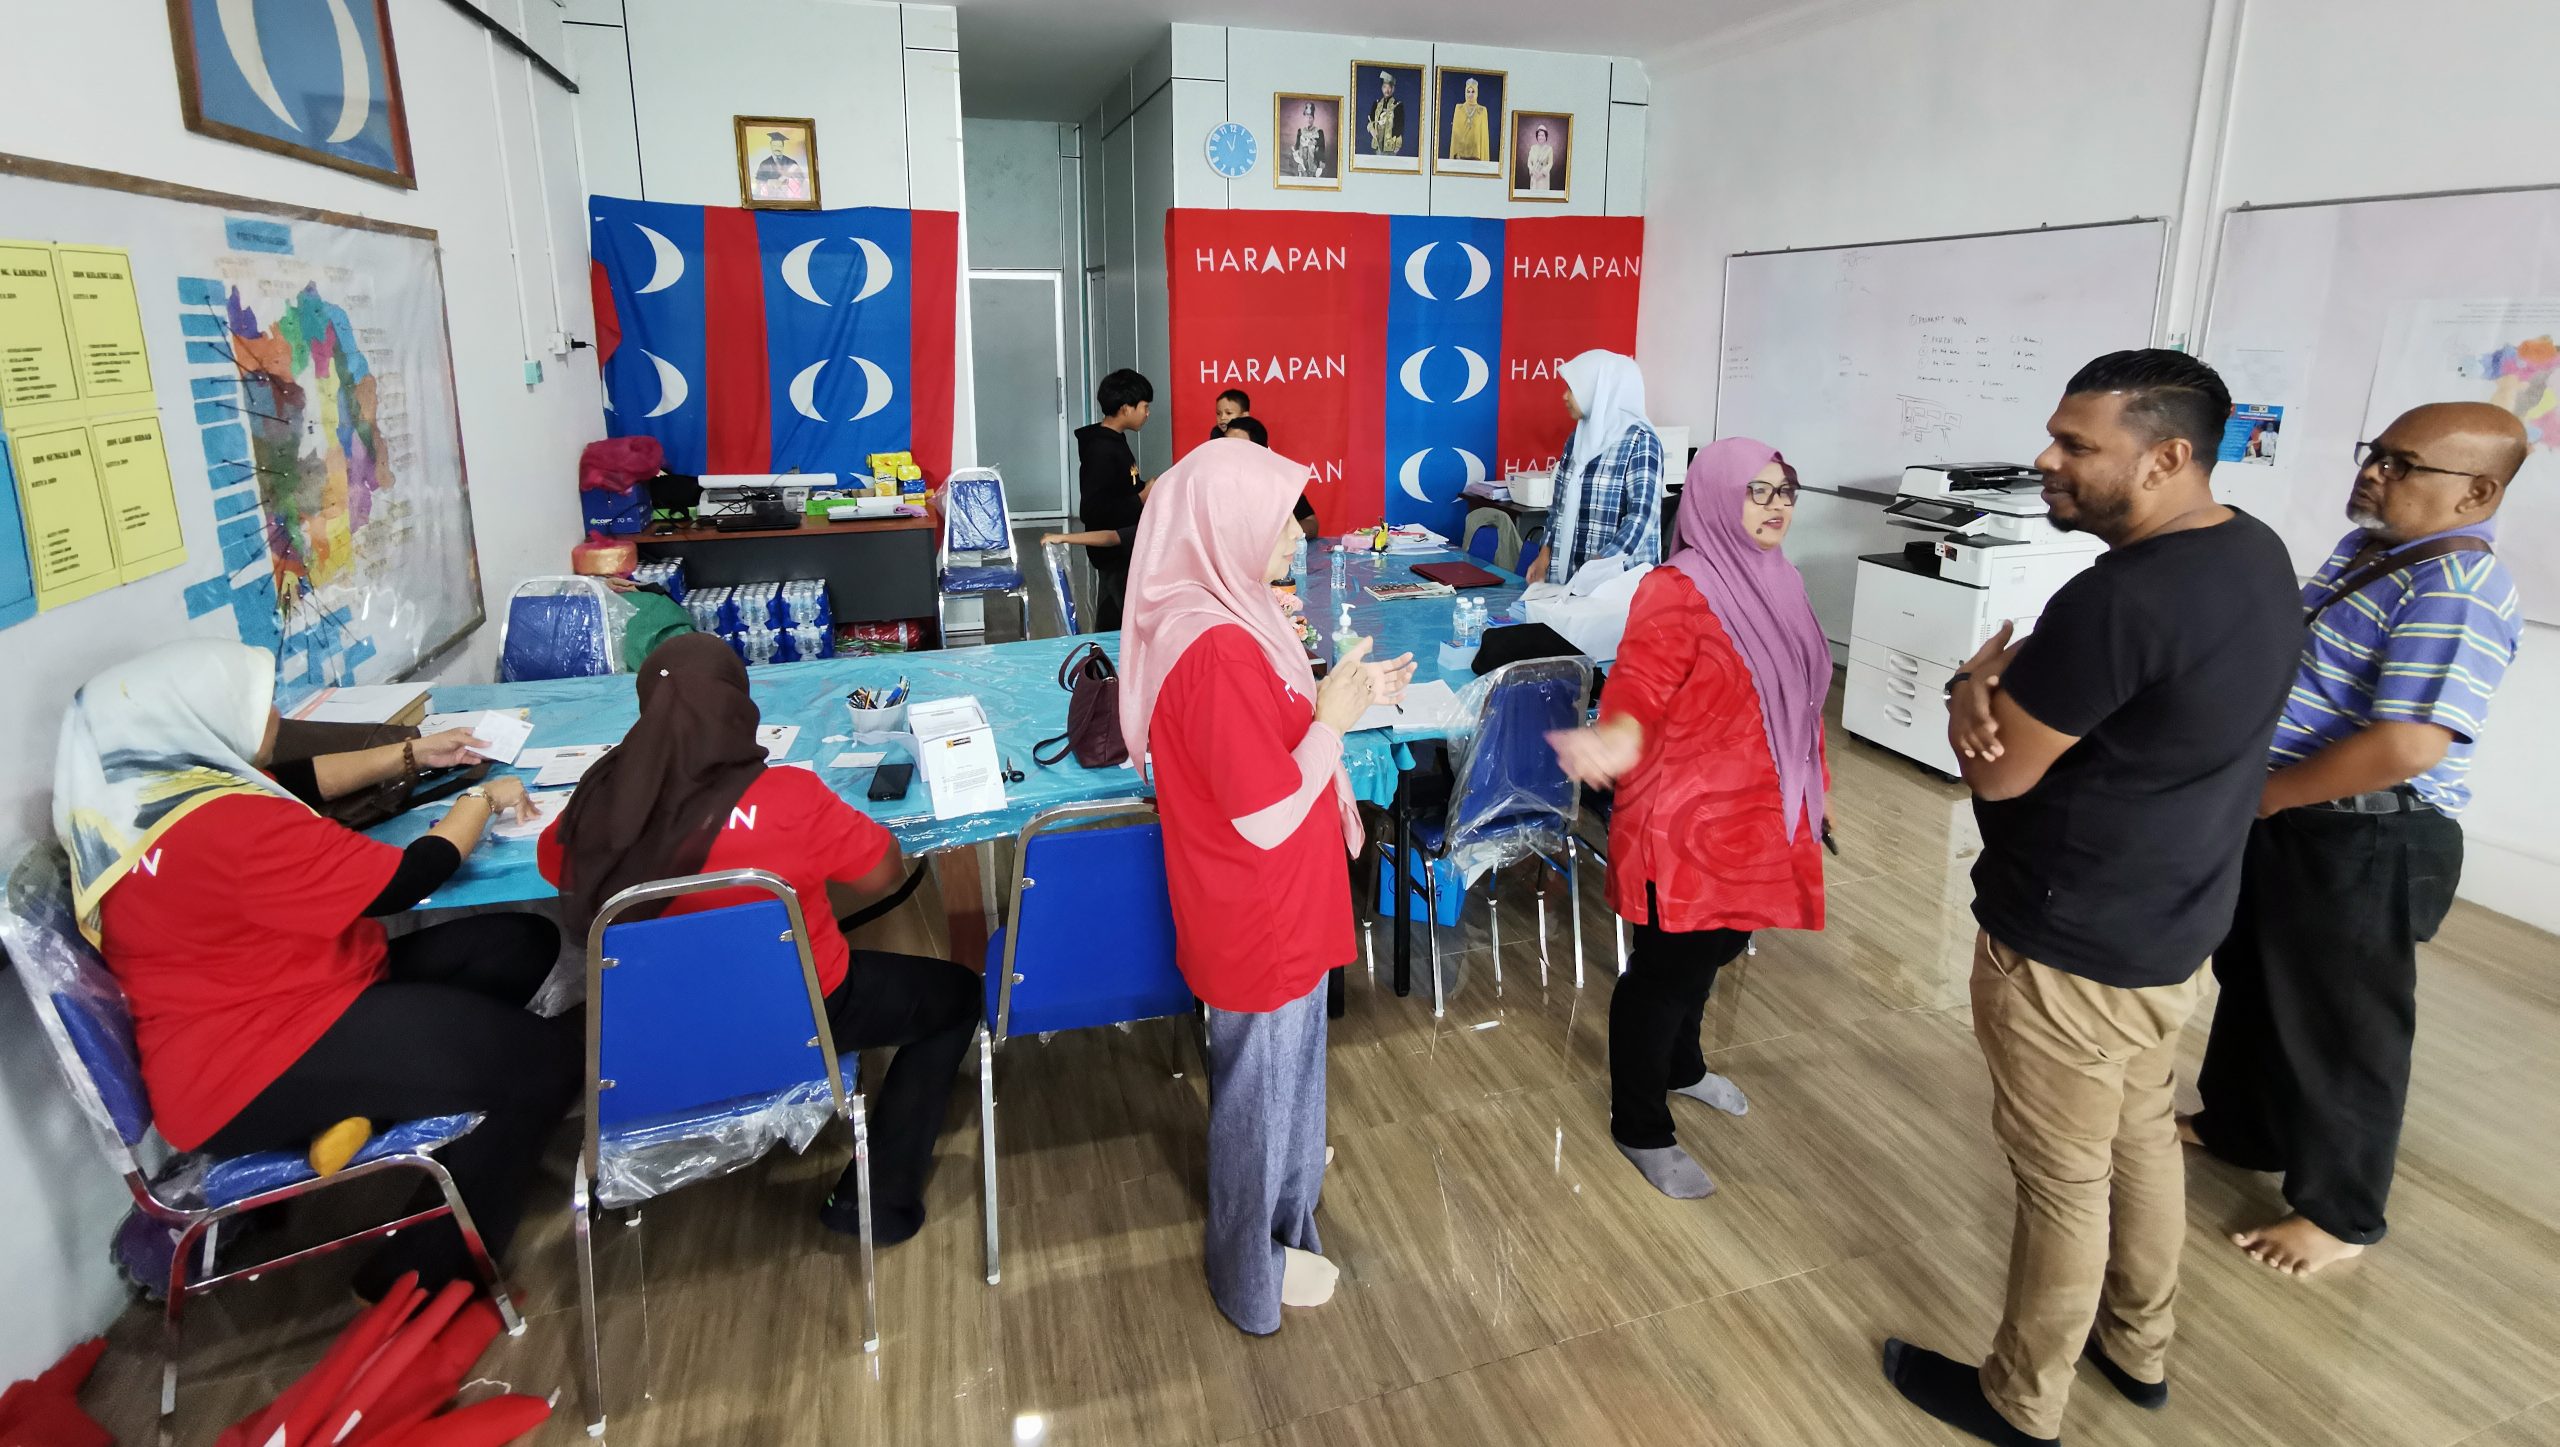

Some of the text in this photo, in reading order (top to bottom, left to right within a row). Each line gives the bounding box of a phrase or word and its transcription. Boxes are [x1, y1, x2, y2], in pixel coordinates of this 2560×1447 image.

[1220, 126, 1227, 135] 11
[1230, 124, 1237, 132] 12
[1196, 245, 1346, 275] HARAPAN
[1513, 253, 1640, 281] HARAPAN
[1200, 354, 1345, 384] HARAPAN
